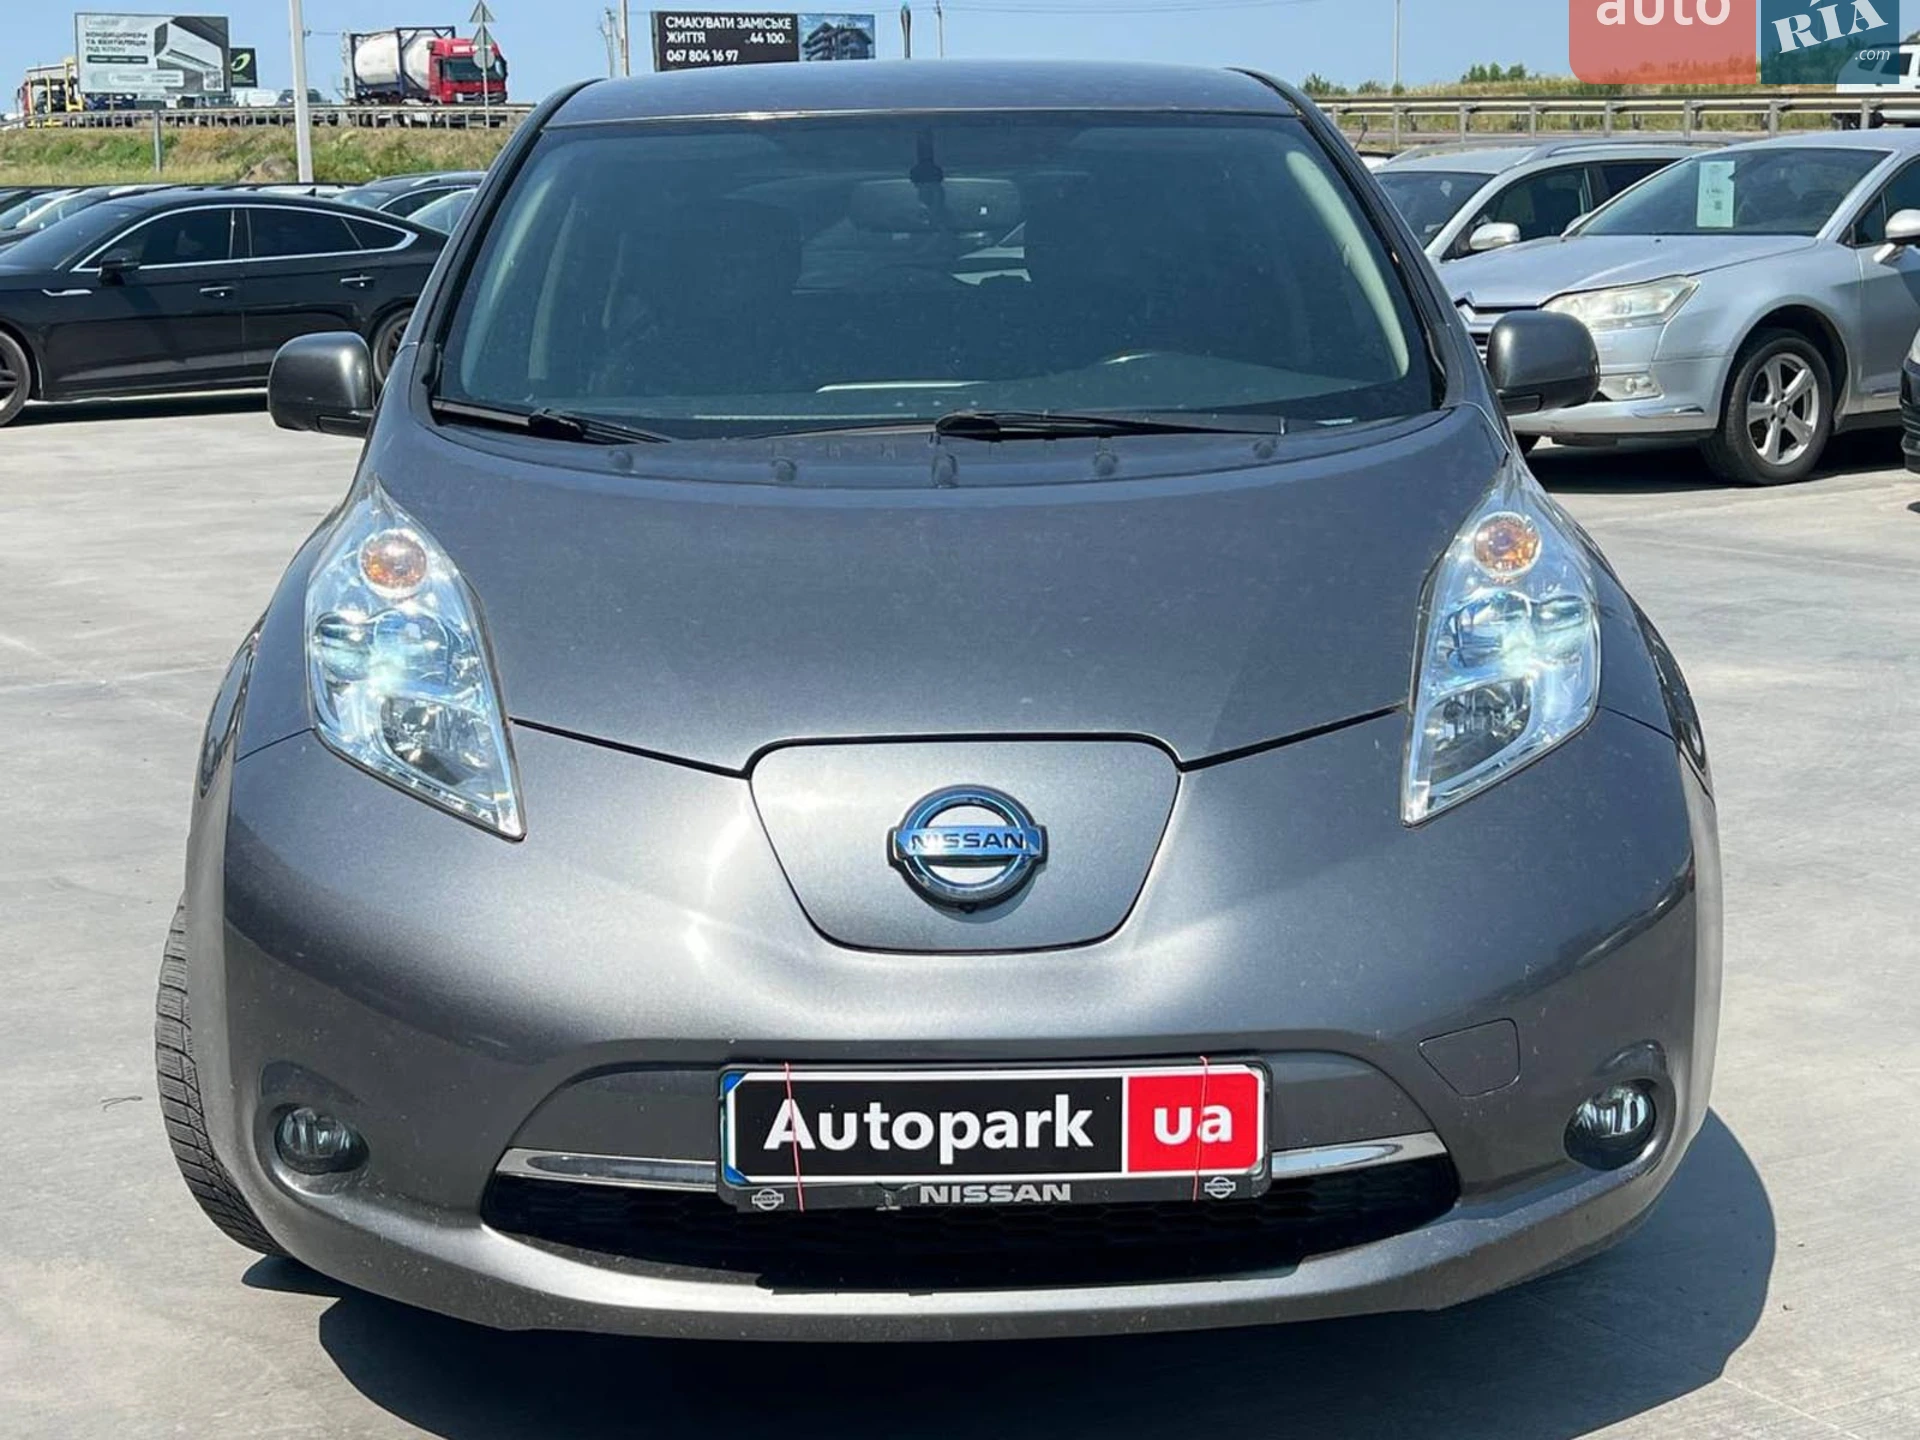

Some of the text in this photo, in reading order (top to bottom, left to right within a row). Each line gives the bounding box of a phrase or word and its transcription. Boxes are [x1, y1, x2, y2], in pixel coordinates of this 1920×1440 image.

[665, 16, 792, 30] СМАКУВАТИ ЗАМІСЬКЕ
[666, 31, 706, 44] ЖИТТЯ
[766, 32, 786, 44] 100
[666, 49, 739, 62] 067 804 16 97
[763, 1094, 1234, 1165] Autopark ua
[919, 1183, 1072, 1204] NISSAN
